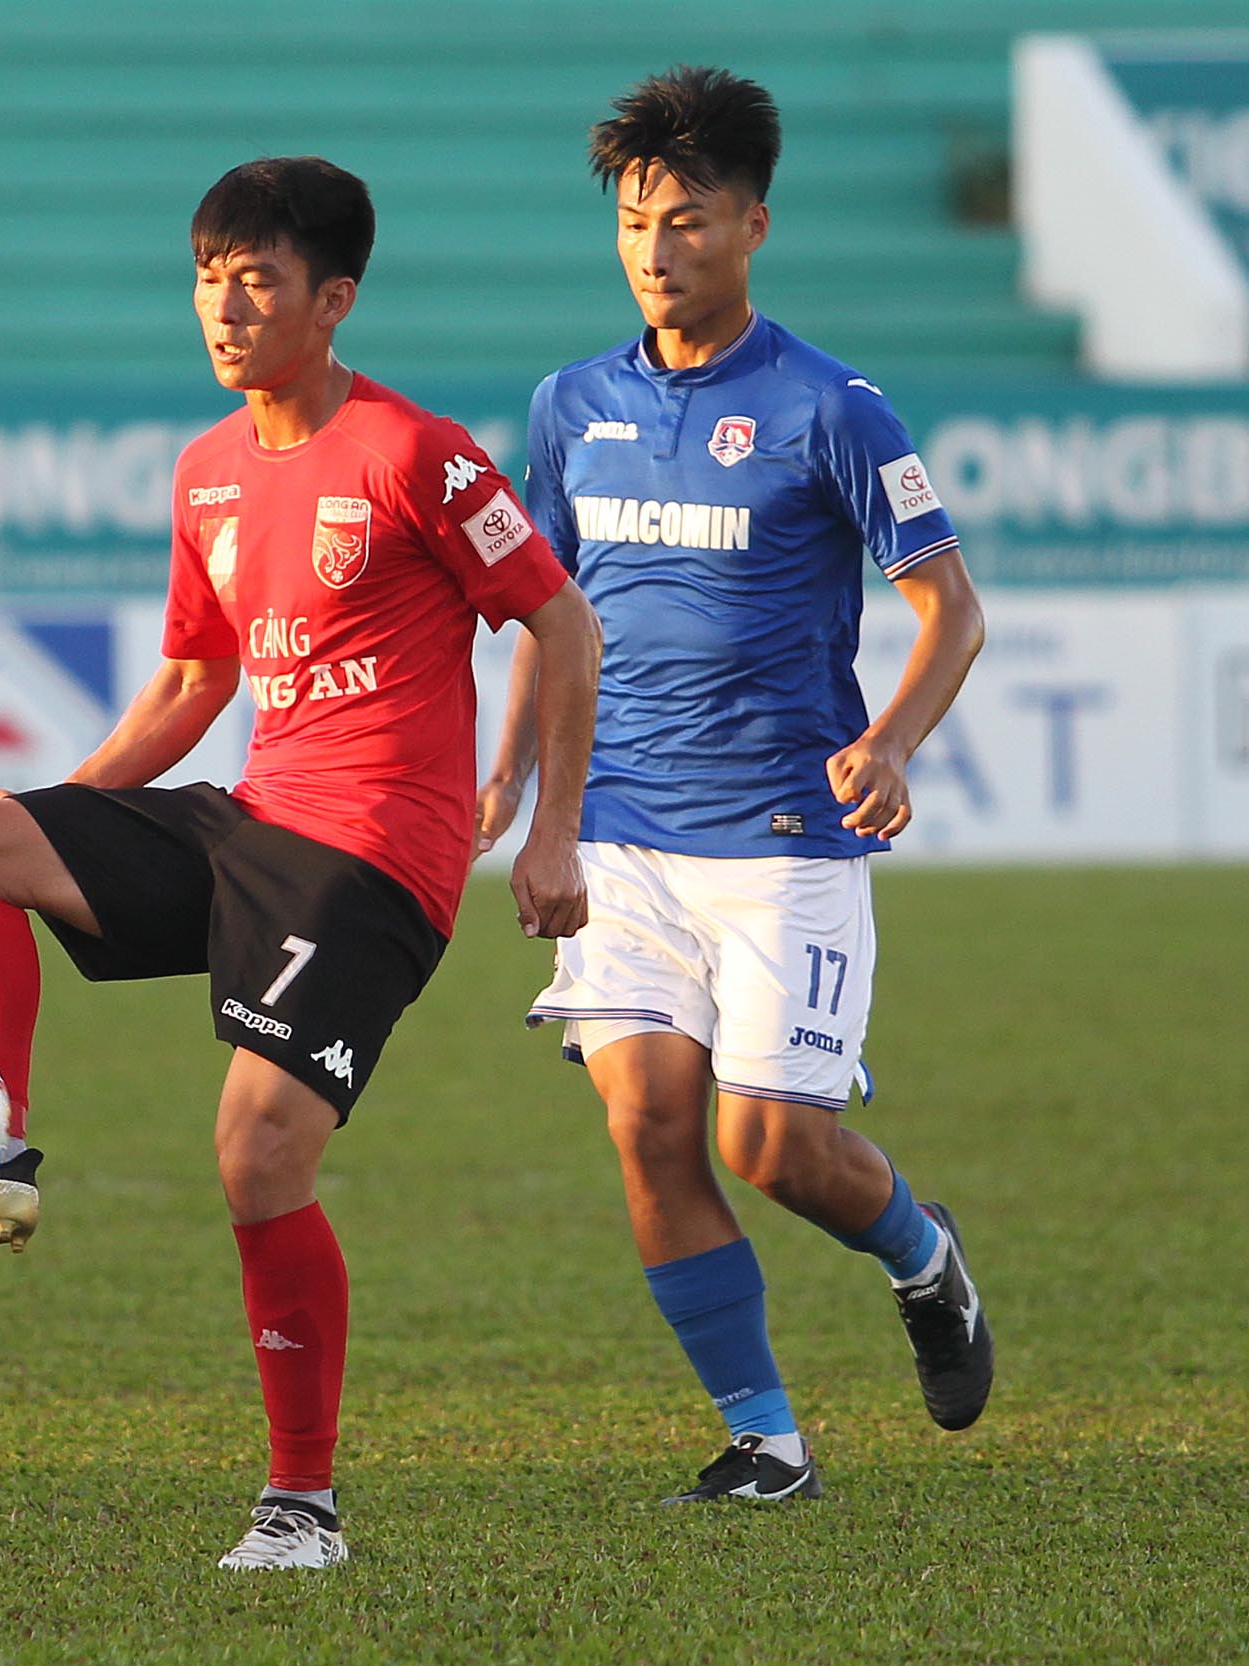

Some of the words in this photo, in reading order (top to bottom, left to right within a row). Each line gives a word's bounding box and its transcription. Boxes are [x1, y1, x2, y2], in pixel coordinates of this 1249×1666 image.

[486, 522, 525, 553] TOYOTA
[574, 496, 750, 550] VINACOMIN
[249, 607, 311, 659] CẢNG
[309, 655, 378, 701] AN
[260, 934, 318, 1007] 7
[805, 943, 847, 1016] 17
[221, 999, 293, 1041] Kappa
